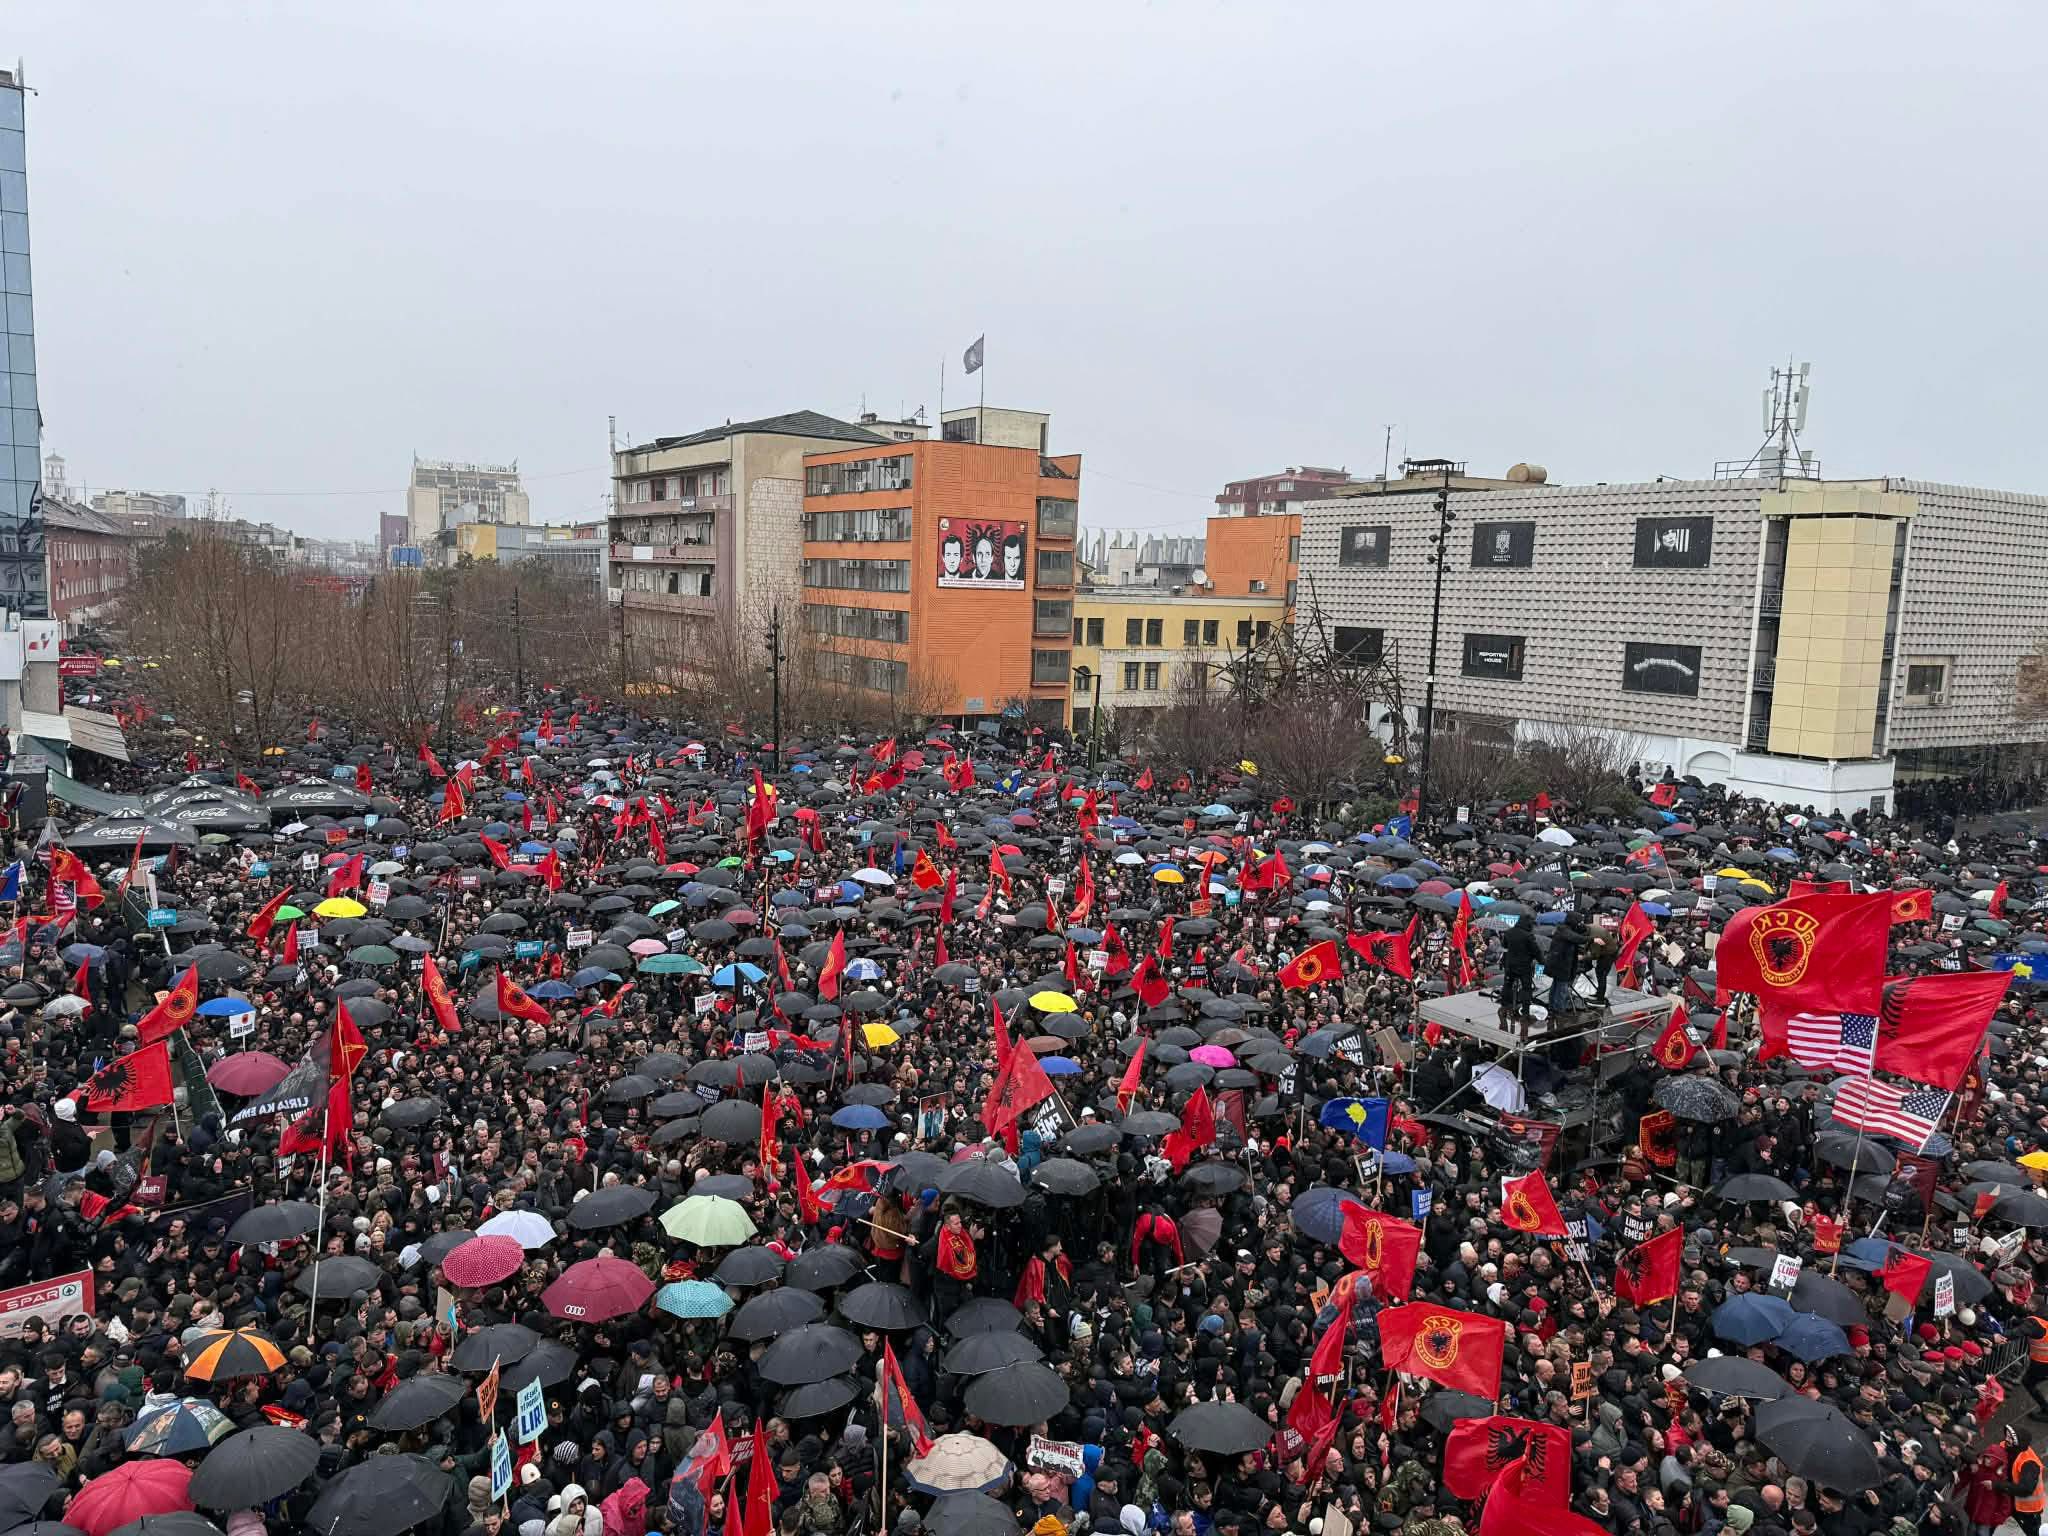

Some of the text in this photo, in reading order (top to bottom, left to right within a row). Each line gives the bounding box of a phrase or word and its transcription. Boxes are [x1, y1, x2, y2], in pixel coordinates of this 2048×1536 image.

[1479, 651, 1508, 659] REPORTING
[1625, 1216, 1644, 1231] LIRIA
[6, 1290, 59, 1310] SPAR
